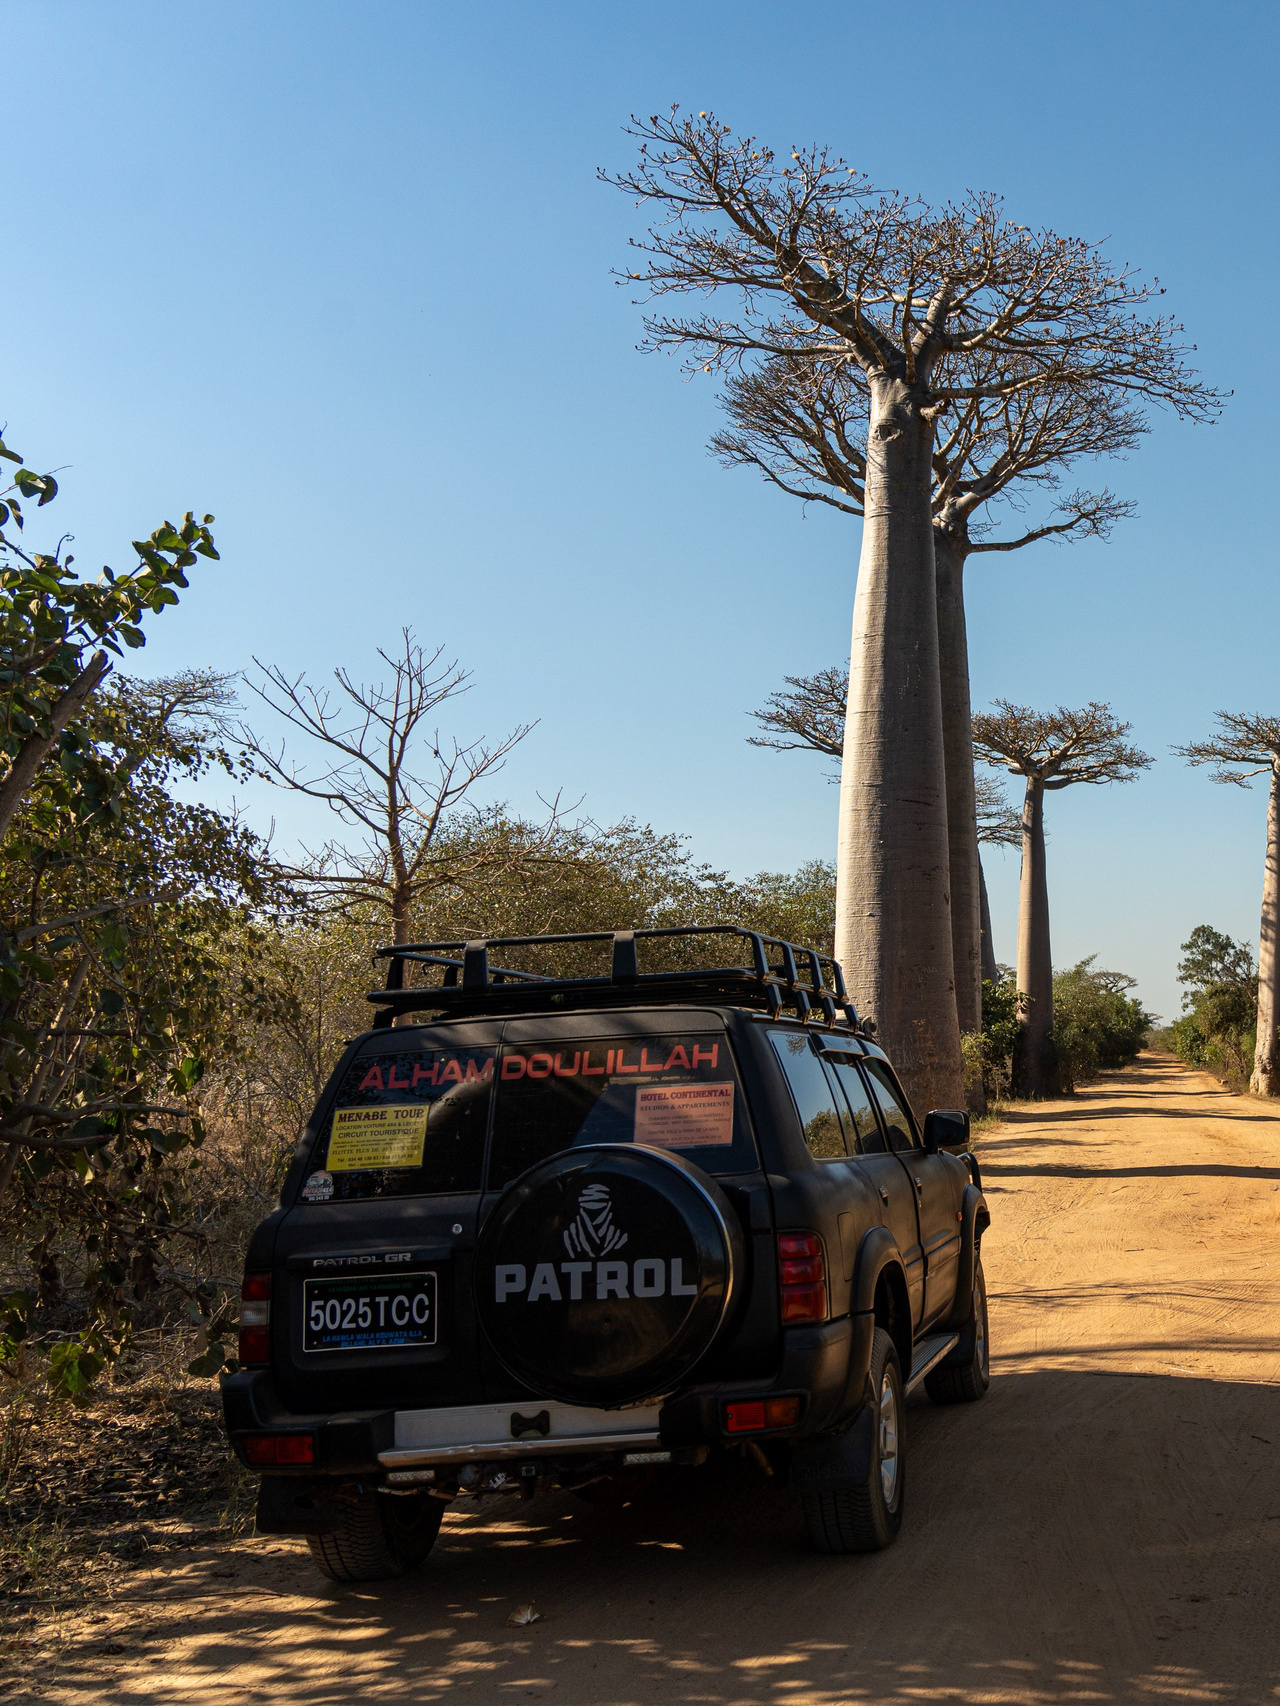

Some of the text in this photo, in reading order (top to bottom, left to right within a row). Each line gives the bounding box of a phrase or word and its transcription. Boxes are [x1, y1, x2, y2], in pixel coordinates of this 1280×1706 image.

[501, 1043, 719, 1080] DOULILLAH
[640, 1089, 731, 1101] HOTEL CONTINENTAL
[677, 1101, 730, 1109] APPARTEMENTS
[338, 1109, 425, 1123] MENABE TOUR
[369, 1128, 420, 1136] TOURISTIQUE
[313, 1253, 412, 1267] PATROL GR
[495, 1258, 697, 1302] PATROL
[310, 1293, 430, 1331] 5025TCC
